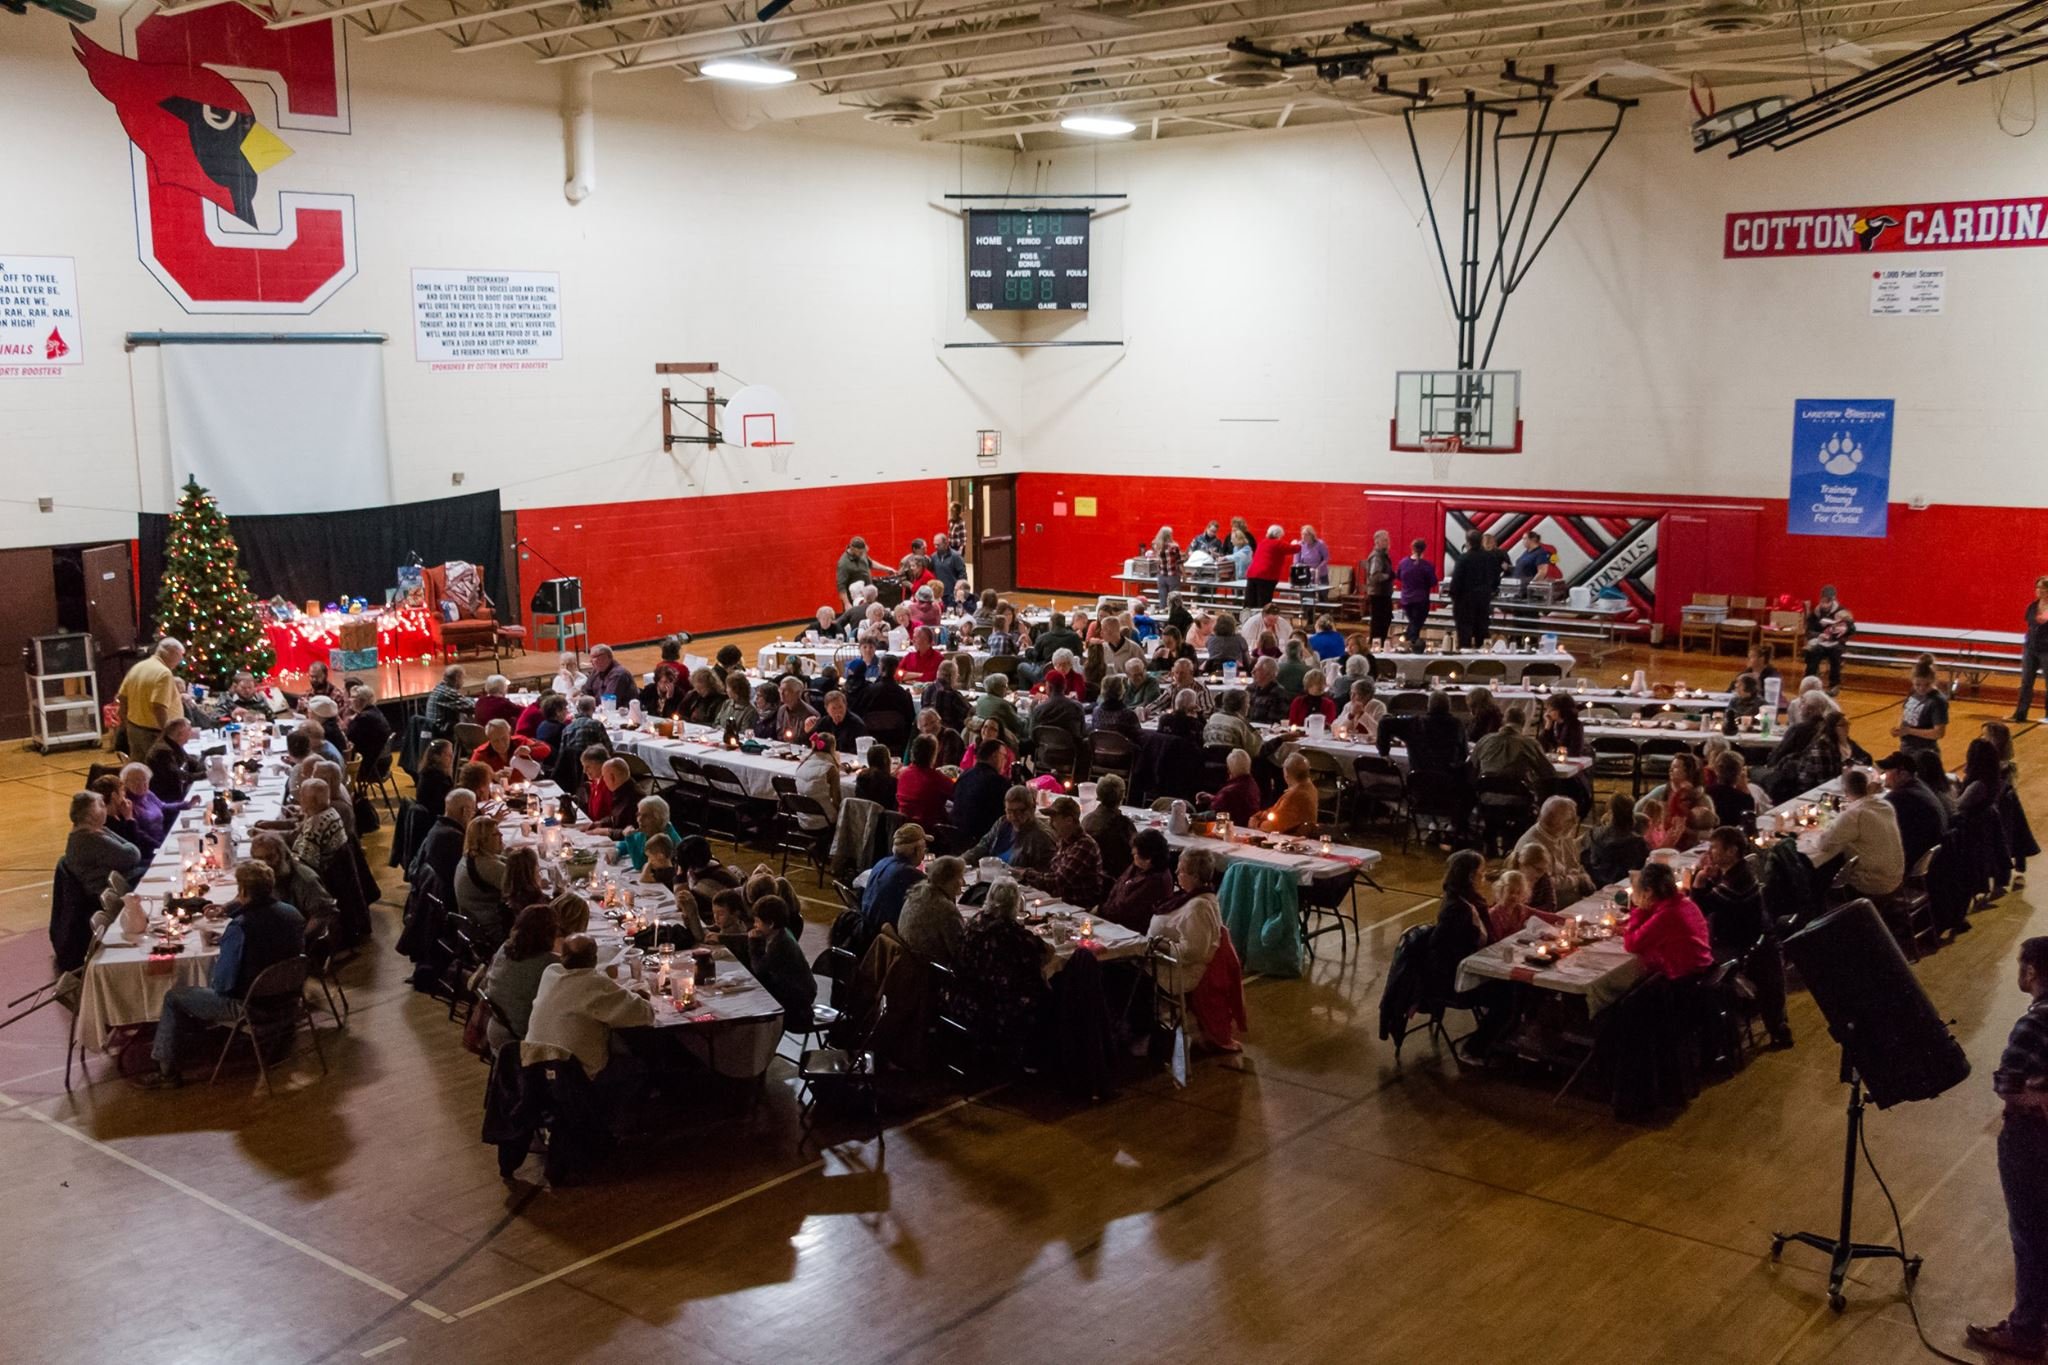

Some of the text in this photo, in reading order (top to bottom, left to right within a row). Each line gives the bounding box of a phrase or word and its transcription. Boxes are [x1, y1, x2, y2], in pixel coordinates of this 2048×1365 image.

[1733, 214, 1857, 251] COTTON
[976, 236, 1084, 246] HOME PERIOD GUEST
[1018, 260, 1041, 268] BONUS
[970, 269, 1088, 278] FOULS PLAYER FOUL FOULS
[3, 274, 18, 283] OFF
[22, 274, 32, 283] TO
[22, 286, 44, 294] EVER
[14, 297, 30, 305] ARE
[976, 302, 1088, 311] WON GAME WON
[11, 319, 35, 328] HIGH!
[22, 367, 62, 376] BOOSTERS
[1821, 484, 1858, 496] Training
[1824, 495, 1853, 507] Young
[1811, 503, 1864, 516] Champions
[1813, 513, 1860, 524] For Christ
[1588, 540, 1649, 598] RDINALS
